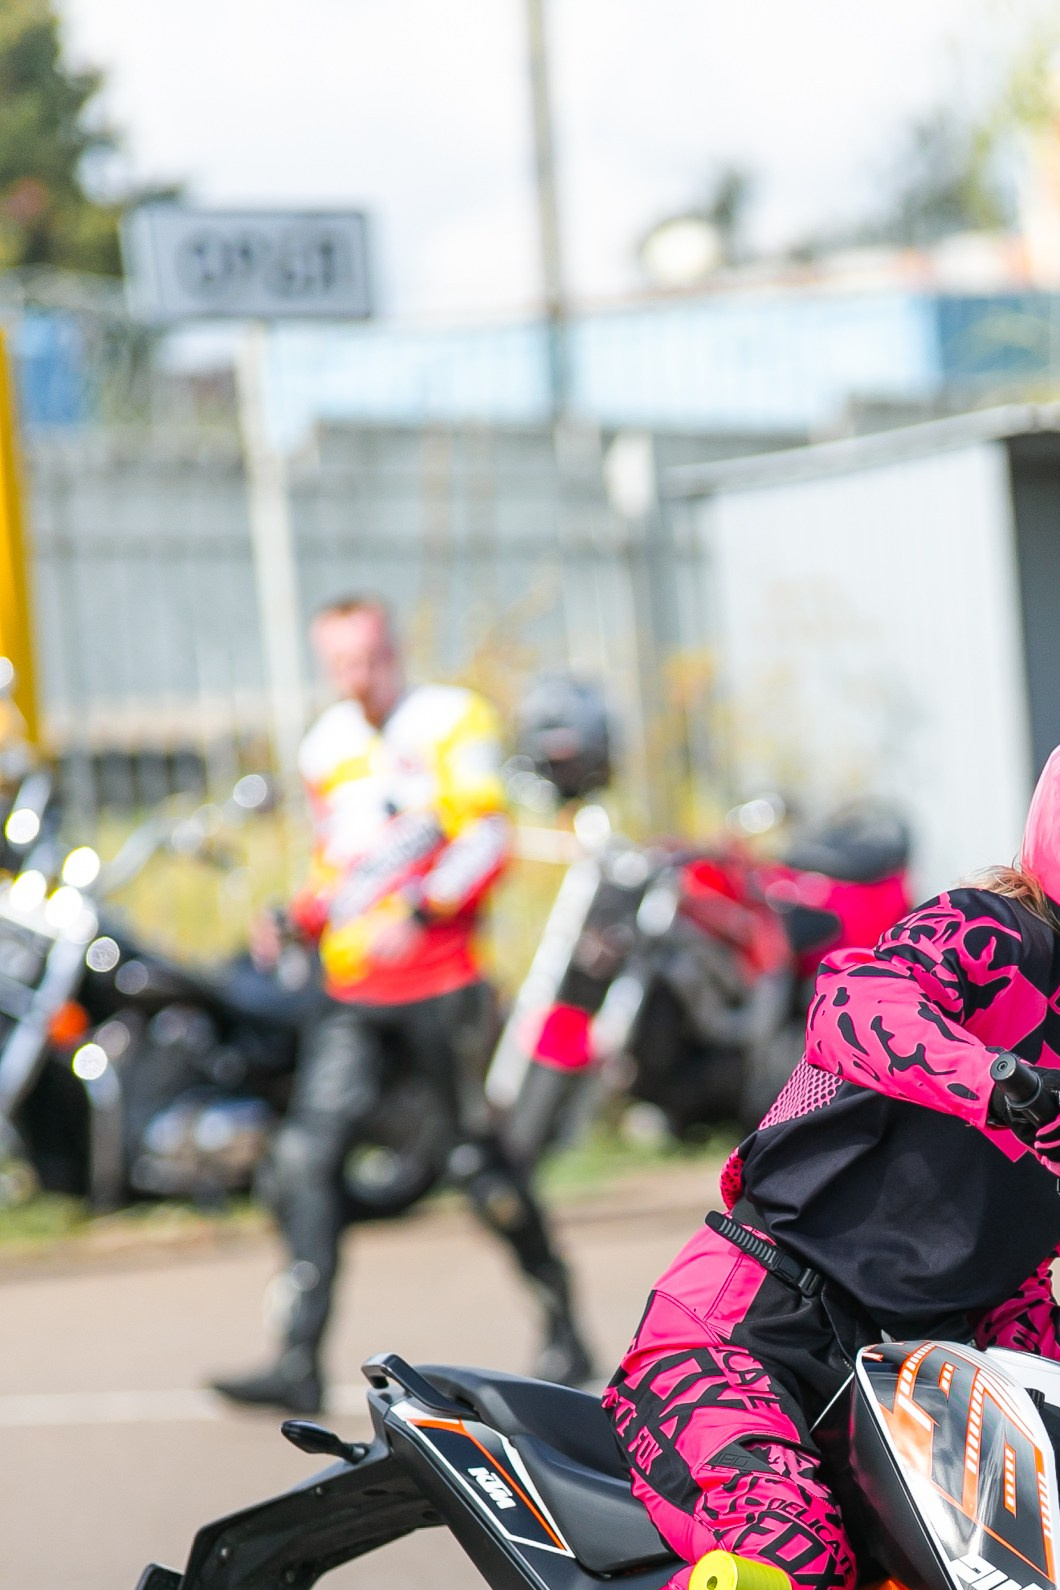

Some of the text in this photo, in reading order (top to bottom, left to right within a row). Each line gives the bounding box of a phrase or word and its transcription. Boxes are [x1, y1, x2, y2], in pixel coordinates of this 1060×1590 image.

[627, 1426, 663, 1475] FOX
[467, 1466, 516, 1509] KTM
[766, 1497, 853, 1579] DELICATE
